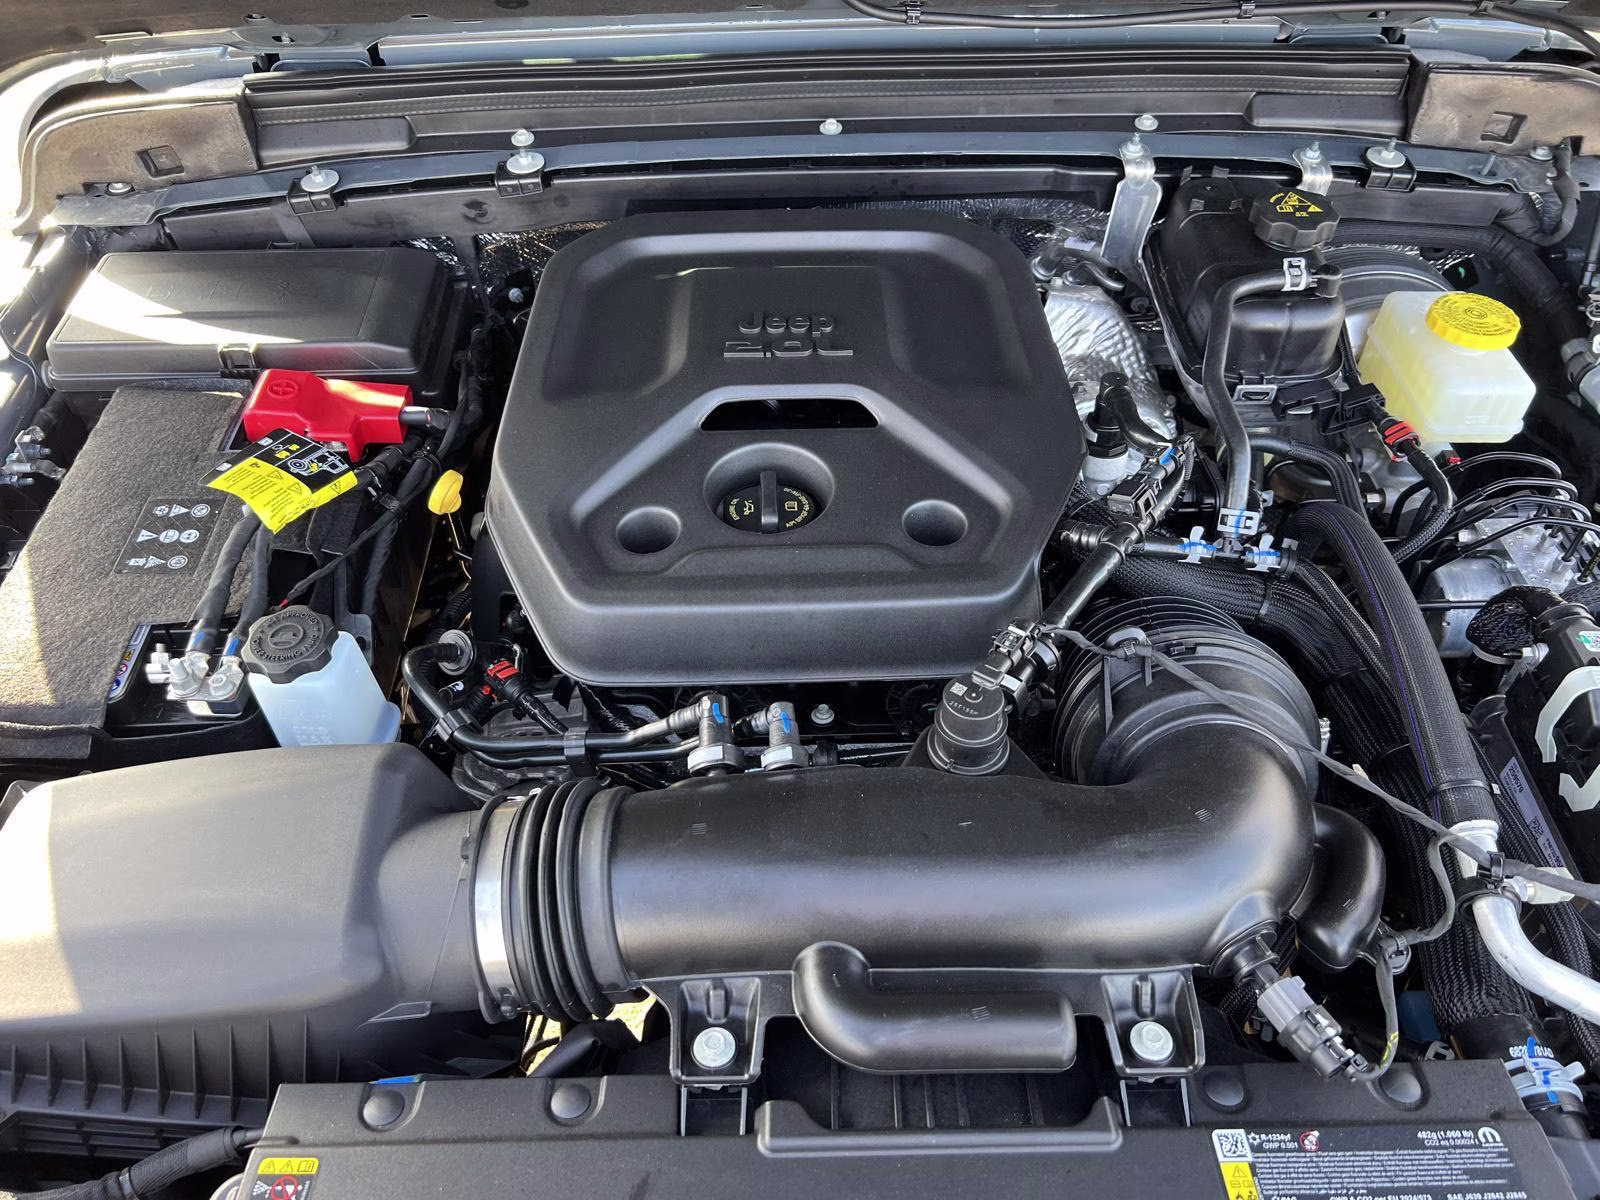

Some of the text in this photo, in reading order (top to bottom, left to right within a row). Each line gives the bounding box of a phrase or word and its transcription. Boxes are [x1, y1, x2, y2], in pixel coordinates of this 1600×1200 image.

[738, 311, 834, 337] Jeep
[724, 338, 854, 358] 2.0L
[280, 610, 318, 625] APPROVED
[262, 648, 302, 662] STEERING
